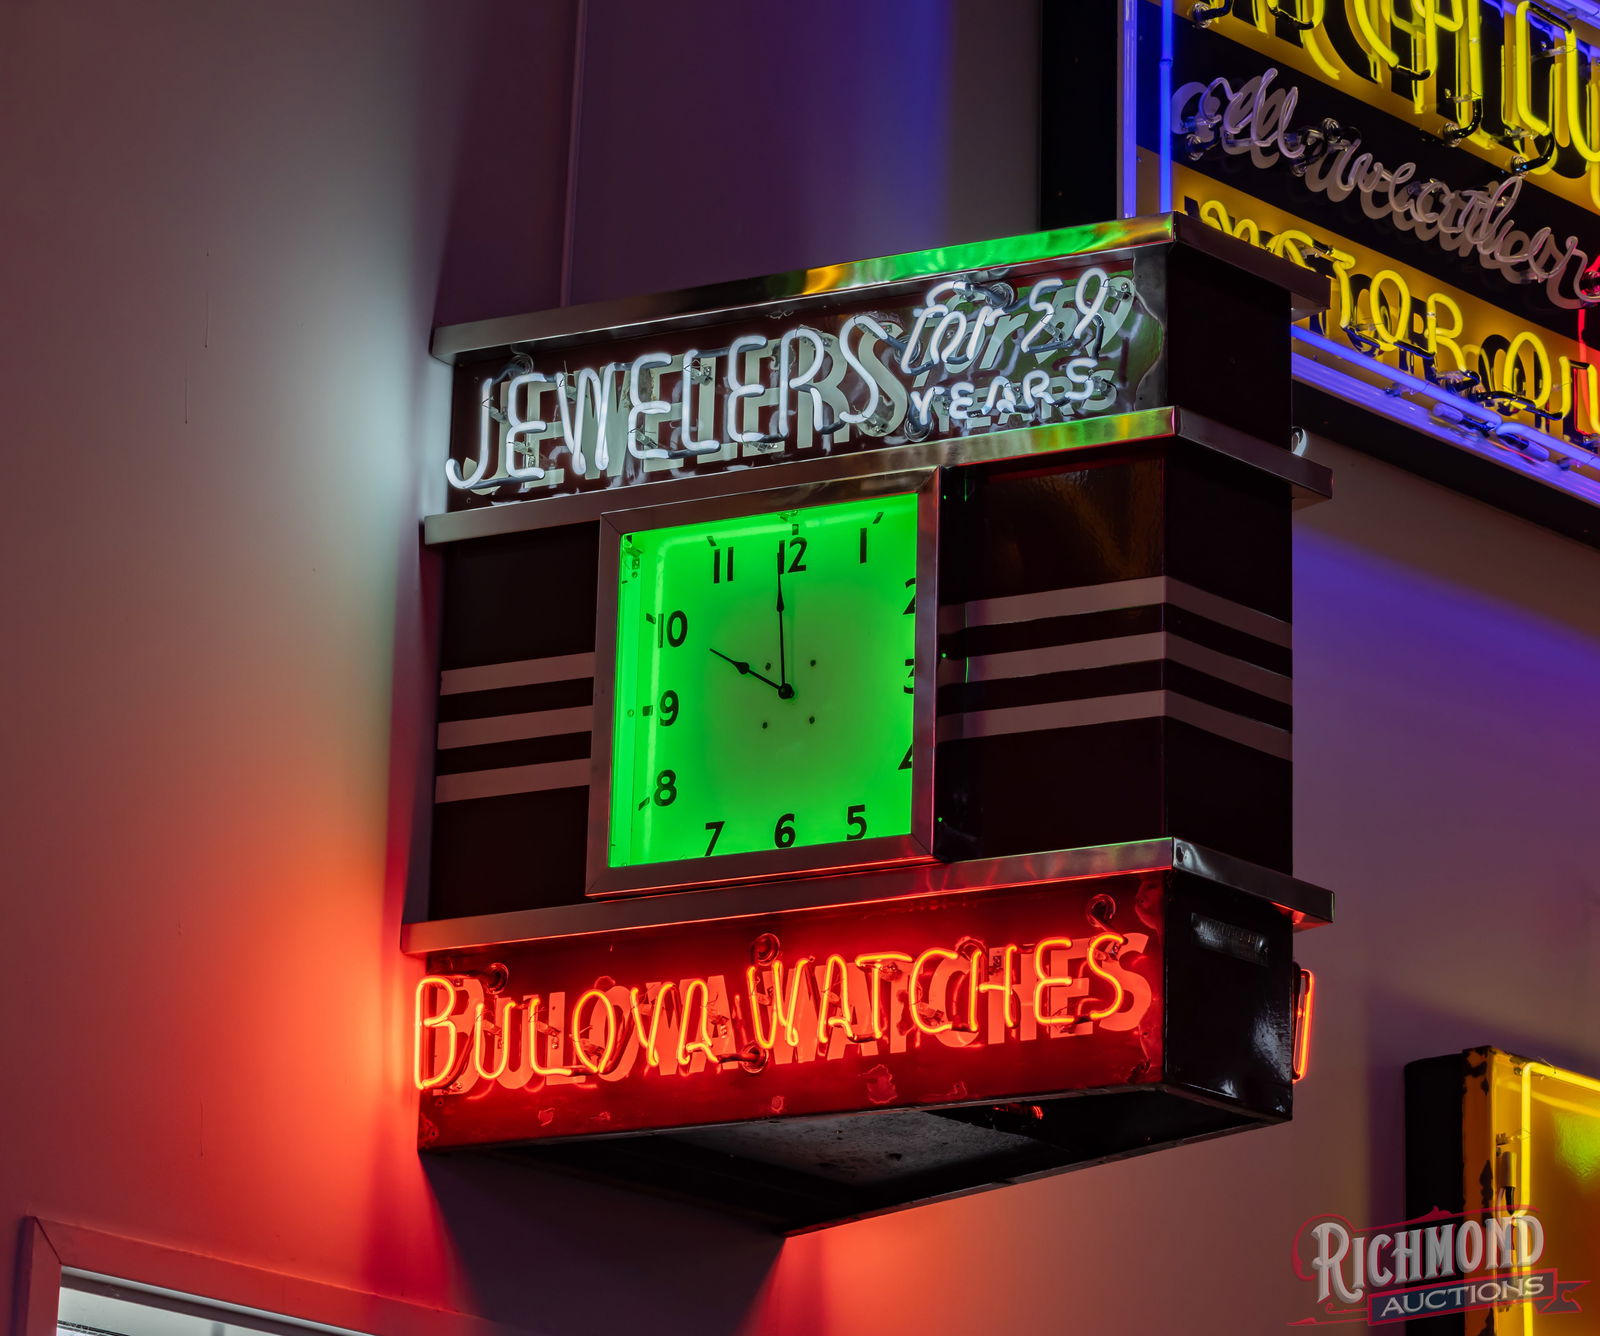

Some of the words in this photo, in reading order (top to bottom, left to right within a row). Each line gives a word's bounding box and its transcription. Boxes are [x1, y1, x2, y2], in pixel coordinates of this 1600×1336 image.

[1330, 140, 1600, 304] weather
[902, 280, 1010, 376] for
[1021, 267, 1115, 356] 59
[446, 313, 897, 491] JEWELERS
[910, 358, 1104, 426] YEARS
[713, 546, 734, 584] 11
[779, 537, 808, 575] 12
[859, 528, 867, 564] 1
[658, 610, 688, 648] 10
[659, 690, 680, 727] 9
[653, 769, 678, 806] 8
[704, 821, 725, 857] 7
[774, 813, 796, 849] 6
[846, 804, 867, 840] 5
[413, 973, 726, 1092] BULOVA
[744, 930, 1138, 1056] WATCHES
